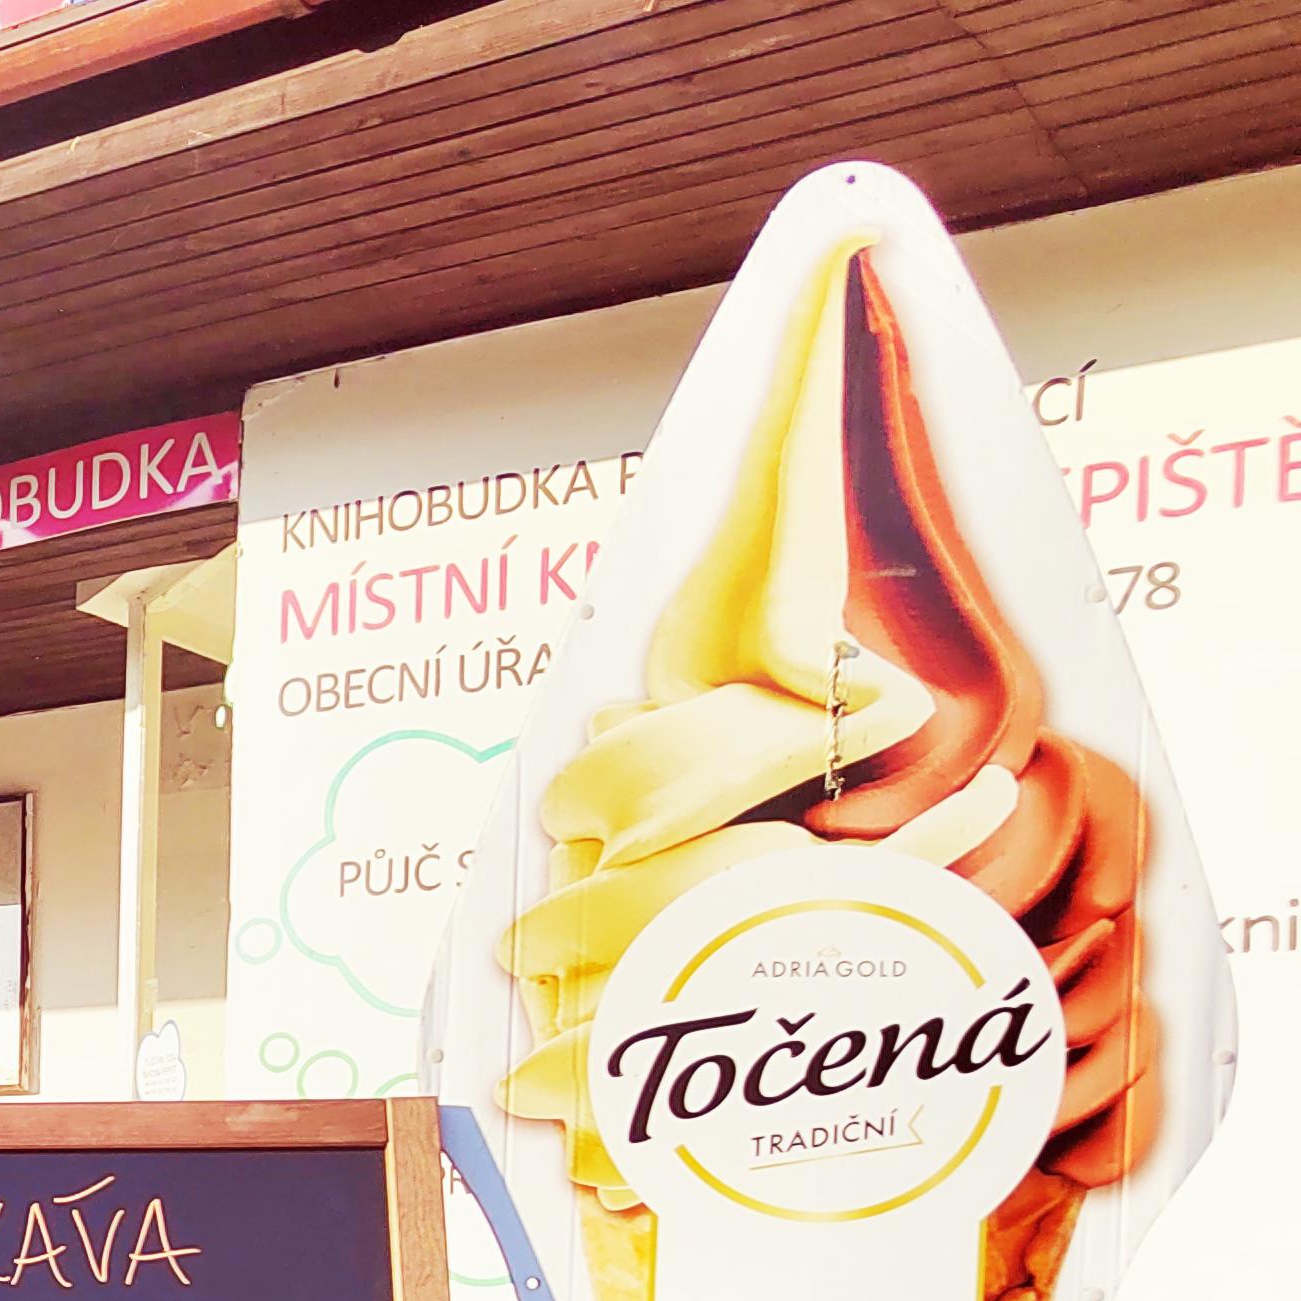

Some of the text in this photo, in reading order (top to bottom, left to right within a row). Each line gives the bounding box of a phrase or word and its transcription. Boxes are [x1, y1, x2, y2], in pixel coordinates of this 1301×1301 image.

[281, 460, 599, 553] KNIHOBUDKA
[1061, 415, 1301, 530] PIŠTĚ
[280, 534, 518, 644] MÍSTNÍ
[1107, 561, 1182, 616] 78
[278, 644, 447, 717] OBECNÍ
[339, 842, 442, 898] PŮJČ
[607, 977, 1052, 1144] Točená
[750, 1109, 899, 1158] TRADIČNÍ
